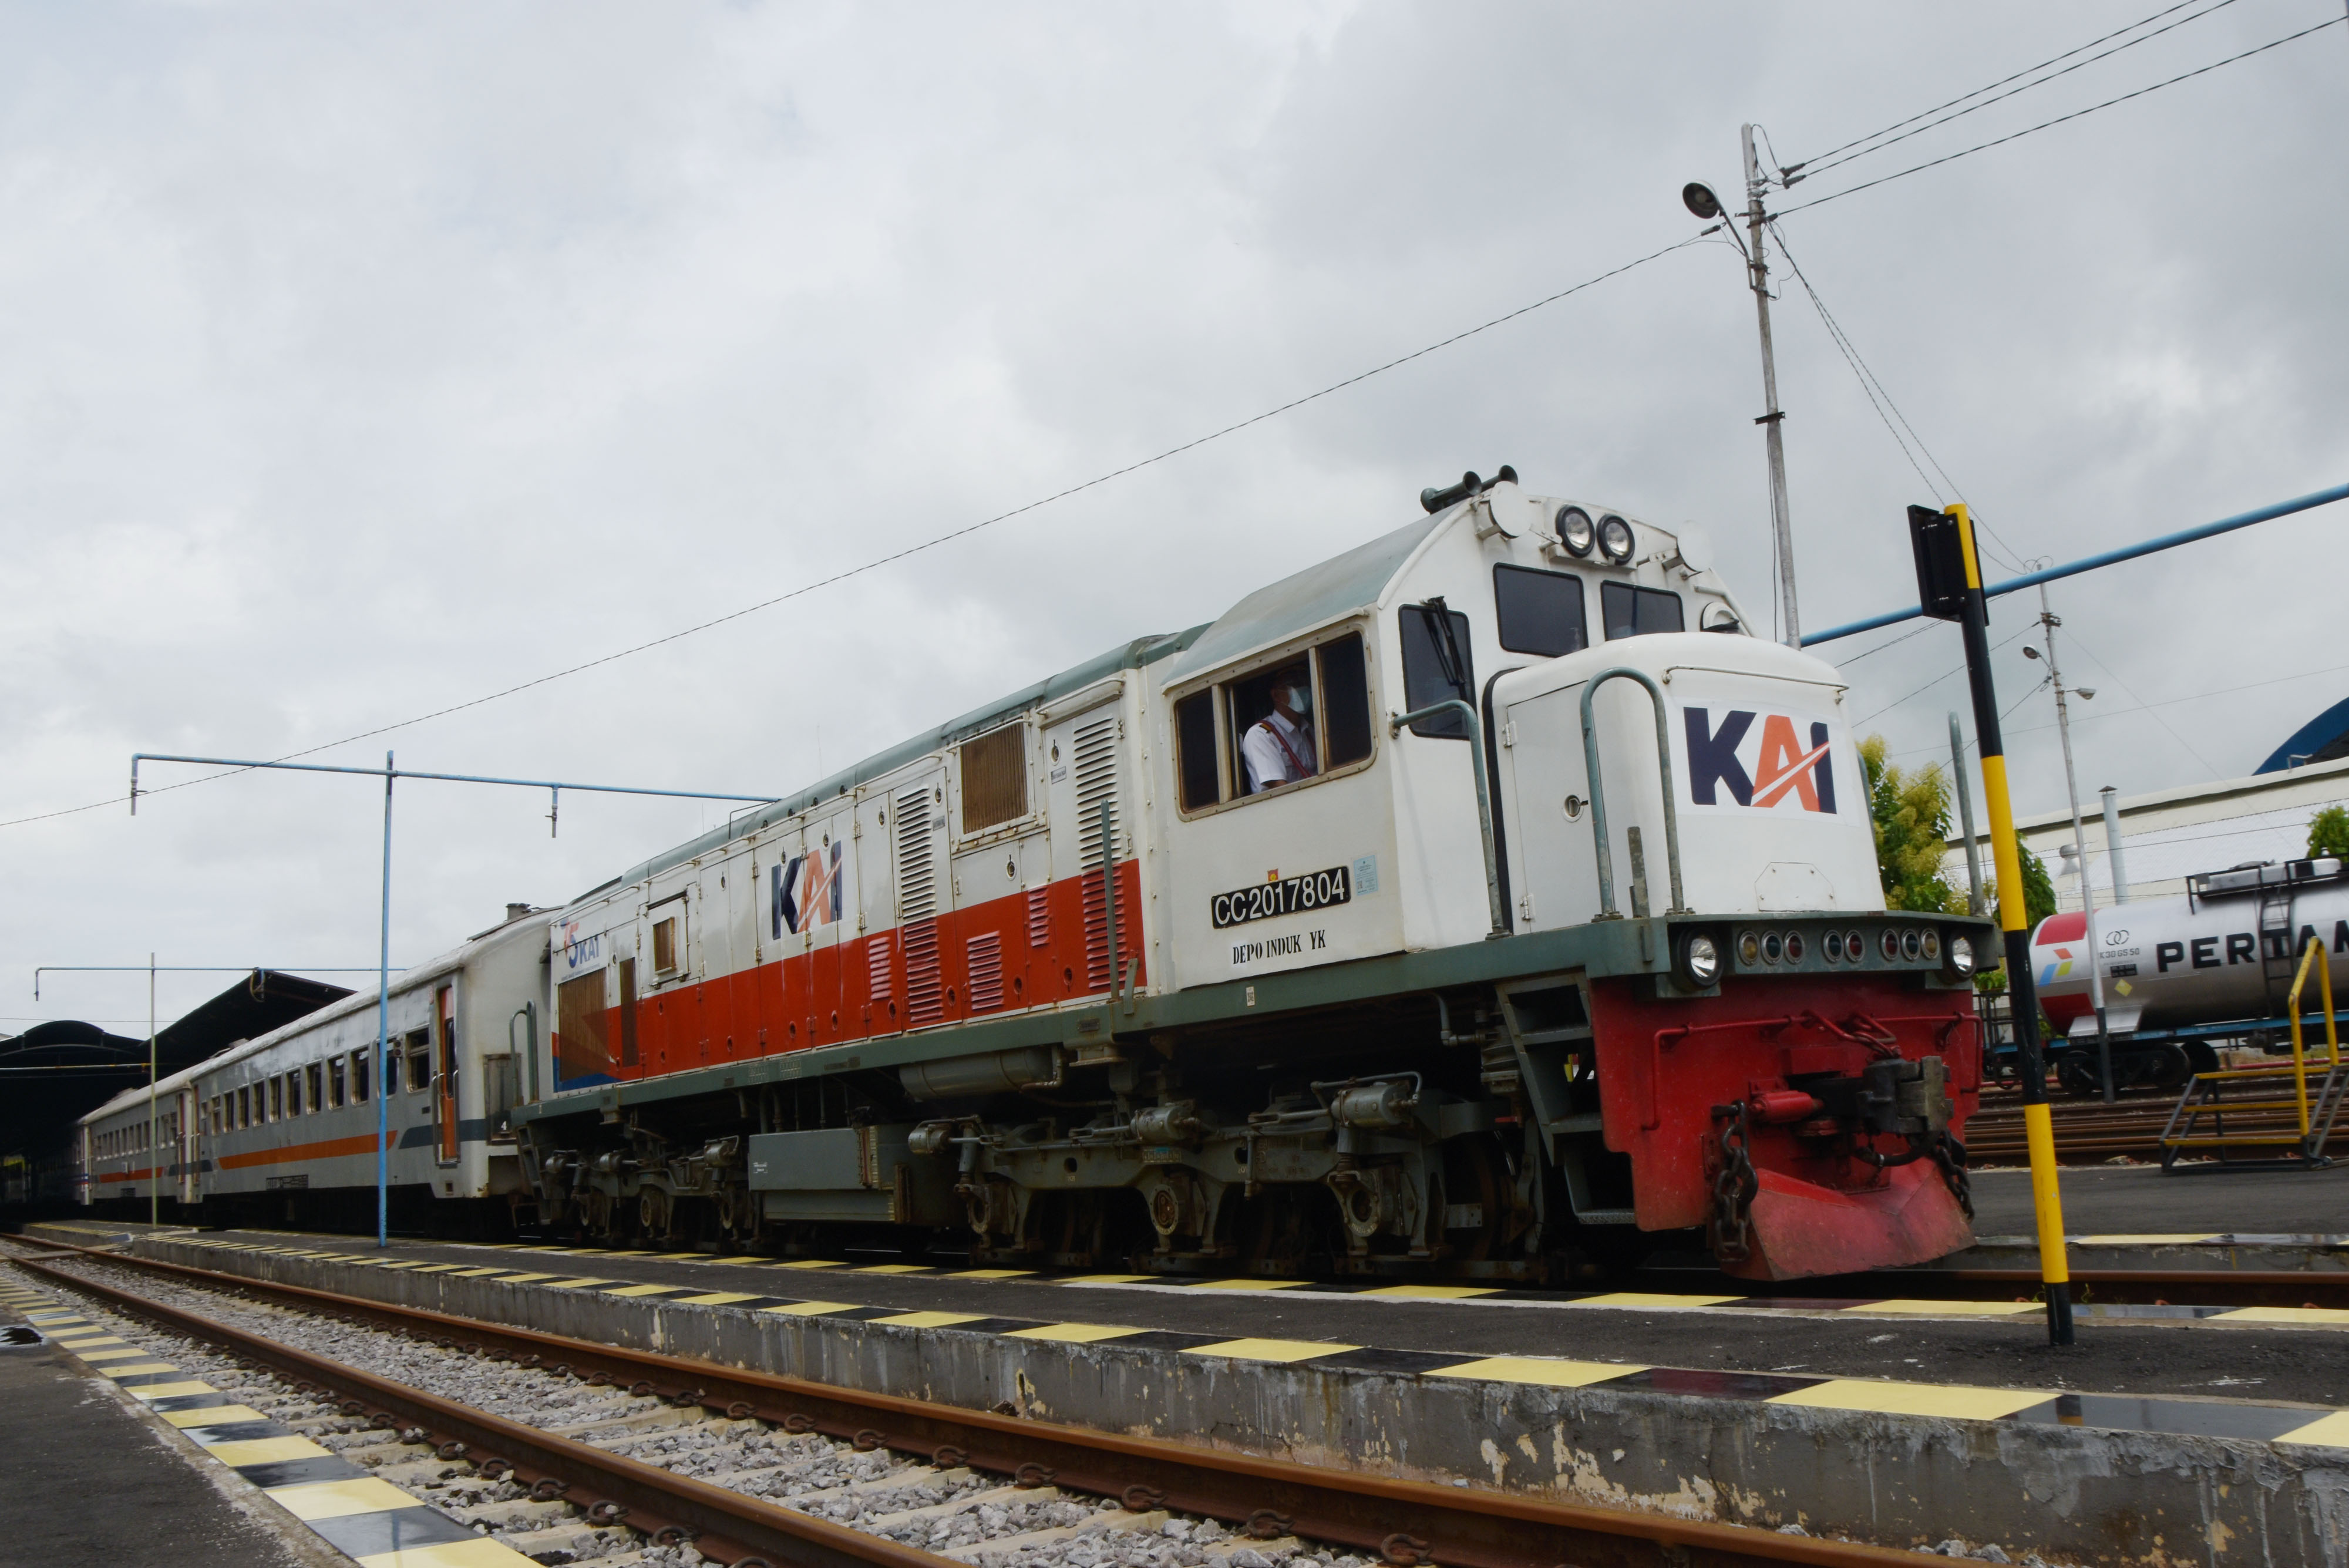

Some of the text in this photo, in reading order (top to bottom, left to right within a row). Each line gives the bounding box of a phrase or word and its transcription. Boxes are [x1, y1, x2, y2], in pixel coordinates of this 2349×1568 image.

[1684, 706, 1838, 815] KAI
[771, 840, 843, 940] KAI
[1215, 869, 1345, 925] CC2017804
[1233, 930, 1326, 964] DEPO INDUK YK
[500, 1120, 508, 1131] 4
